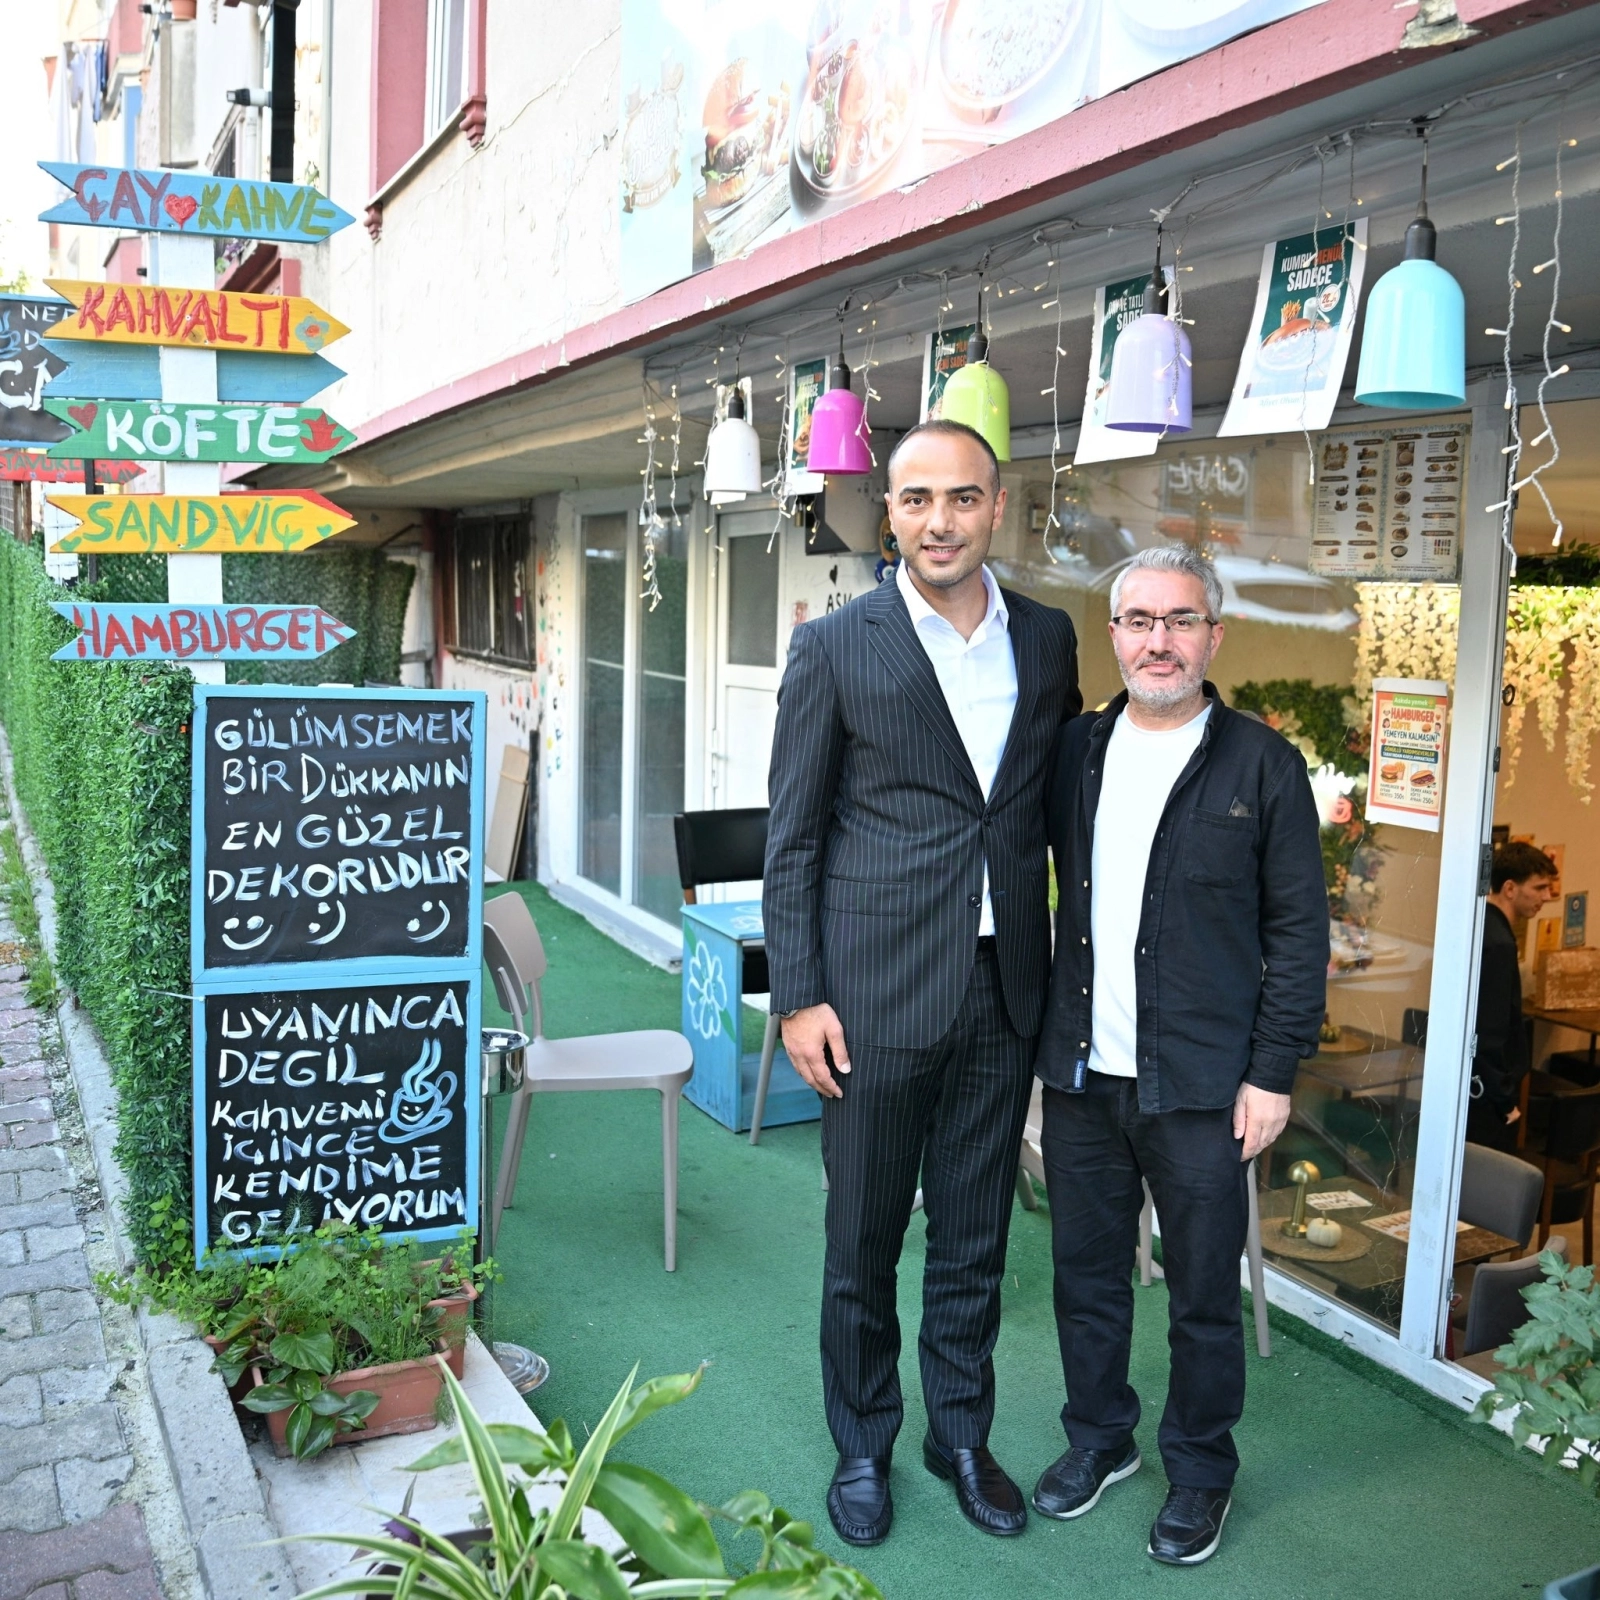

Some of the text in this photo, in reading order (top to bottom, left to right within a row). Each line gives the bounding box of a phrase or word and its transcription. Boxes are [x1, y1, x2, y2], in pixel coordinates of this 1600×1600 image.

[73, 169, 336, 235] ÇAY KAHVE
[1287, 264, 1333, 292] SADECE
[79, 285, 290, 349] KAHVALTI
[1117, 308, 1144, 331] SADE
[106, 402, 301, 458] KÖFTE
[82, 497, 304, 550] SANDVİÇ
[72, 605, 348, 658] HAMBURGER
[214, 705, 472, 751] GÜLÜMSEMEK
[1391, 707, 1435, 723] HAMBURGER
[223, 752, 469, 803] BİR DÜKKANIN
[221, 820, 282, 850] EN
[208, 845, 470, 904] DEKORUDUR
[221, 988, 465, 1041] UYANINCA
[213, 1145, 443, 1203] KENDİME
